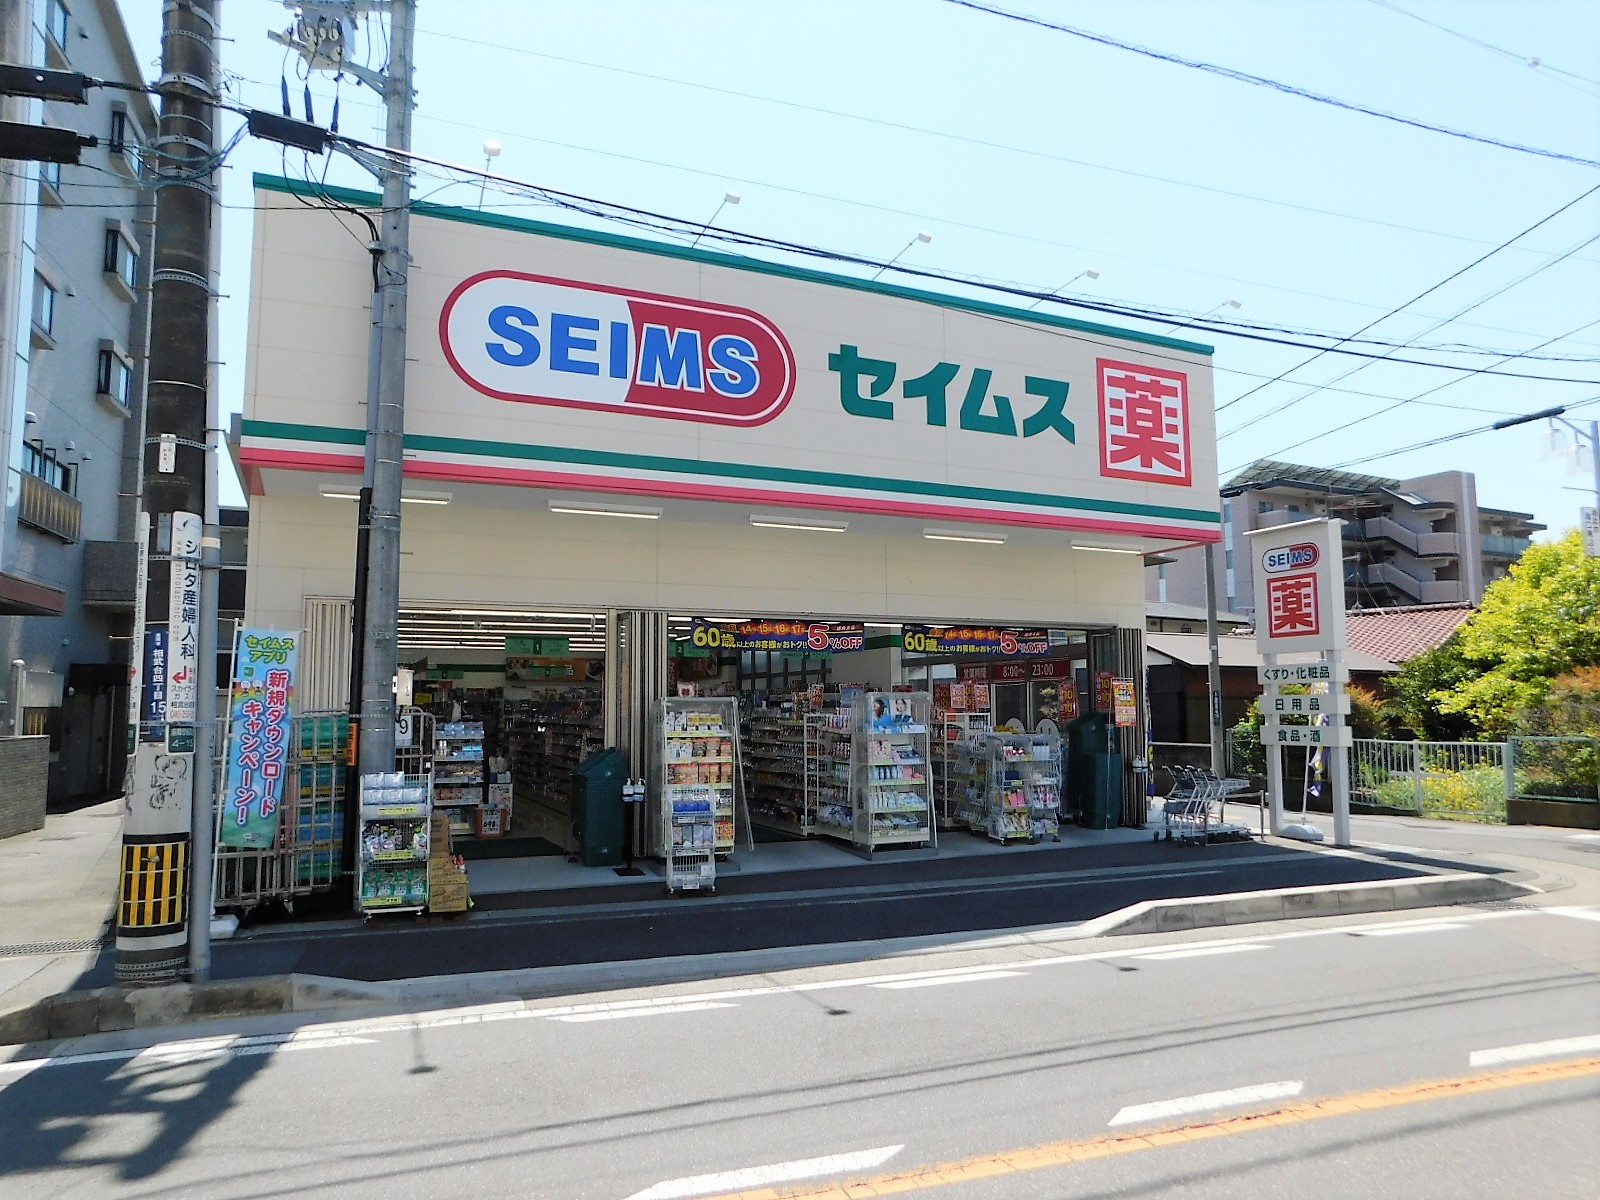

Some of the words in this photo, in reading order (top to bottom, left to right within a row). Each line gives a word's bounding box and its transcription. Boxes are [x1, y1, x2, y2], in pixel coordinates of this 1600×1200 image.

[485, 304, 760, 398] SEIMS
[827, 343, 1076, 446] セイムス
[1105, 373, 1183, 473] 薬
[1268, 549, 1313, 567] SEIMS
[1271, 579, 1314, 630] 薬
[246, 634, 294, 651] セイムス
[250, 650, 288, 664] アプリ
[1032, 663, 1054, 676] 23:00
[1263, 665, 1330, 680] くすり・化粧品
[149, 701, 167, 714] 15
[1275, 697, 1320, 711] 日用品
[260, 669, 289, 818] 新規ダウンロード
[1277, 728, 1321, 743] 食品・酒
